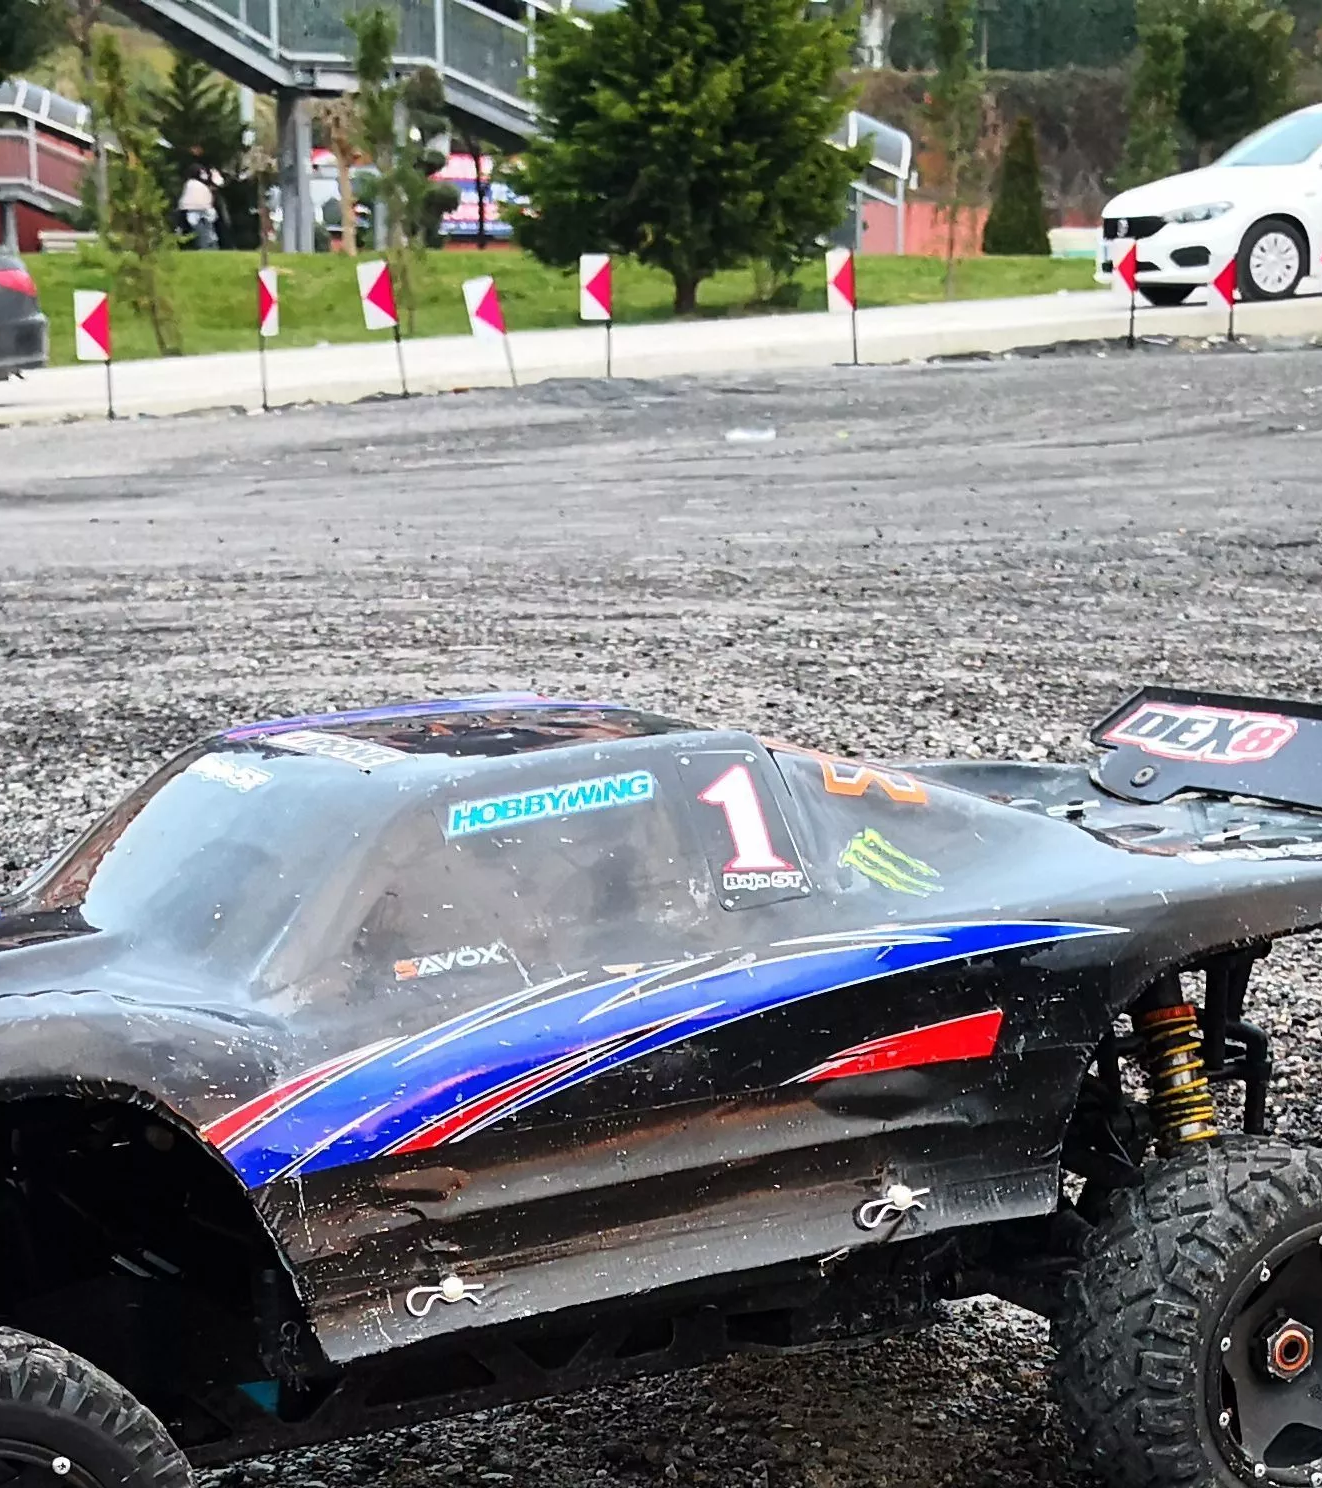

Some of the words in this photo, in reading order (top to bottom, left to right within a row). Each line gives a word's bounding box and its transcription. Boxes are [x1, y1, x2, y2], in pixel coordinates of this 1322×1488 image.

[1114, 709, 1290, 758] DEX8
[451, 774, 651, 833] HOBBYWING
[697, 765, 795, 872] 1
